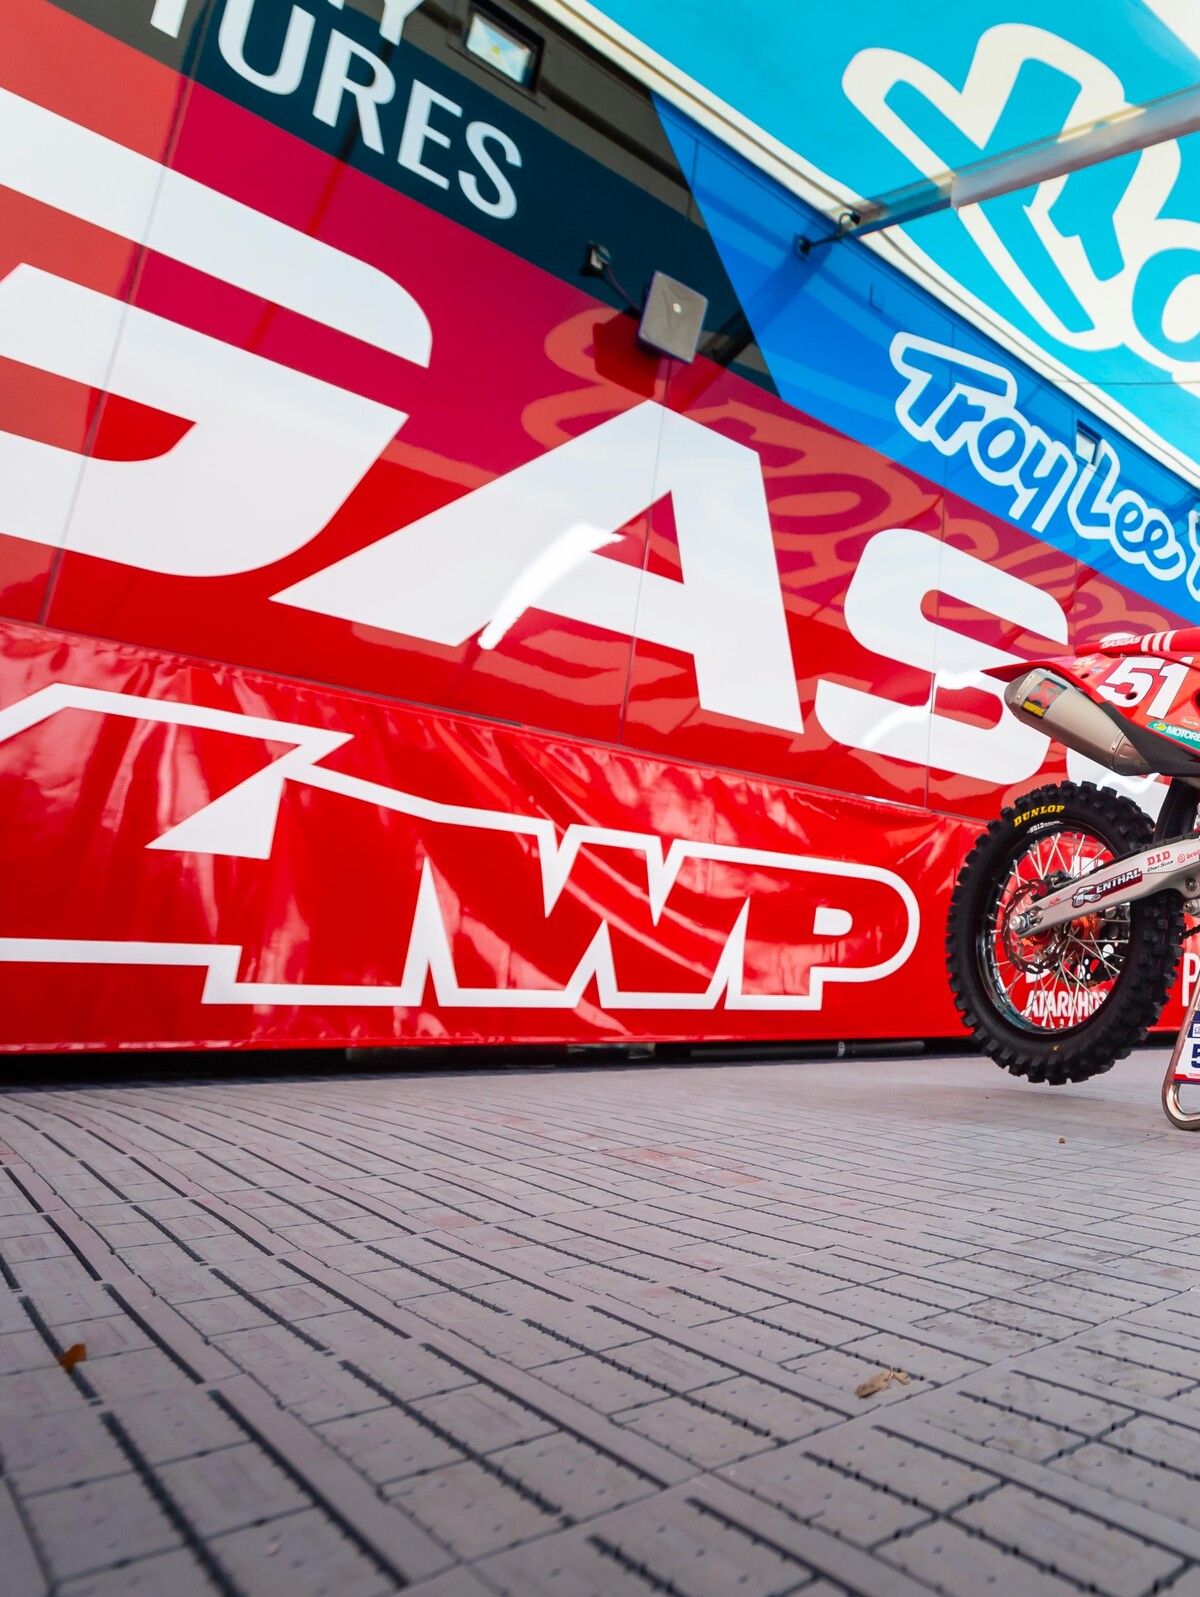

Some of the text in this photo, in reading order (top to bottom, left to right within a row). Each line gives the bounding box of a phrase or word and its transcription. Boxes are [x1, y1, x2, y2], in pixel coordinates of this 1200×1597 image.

[149, 0, 523, 220] URES
[889, 331, 1078, 534] Troy
[1068, 439, 1187, 582] Lee
[1101, 635, 1143, 649] GASGAS
[1095, 655, 1195, 720] 51
[1013, 804, 1066, 828] DUNLOP
[1146, 850, 1171, 866] DID
